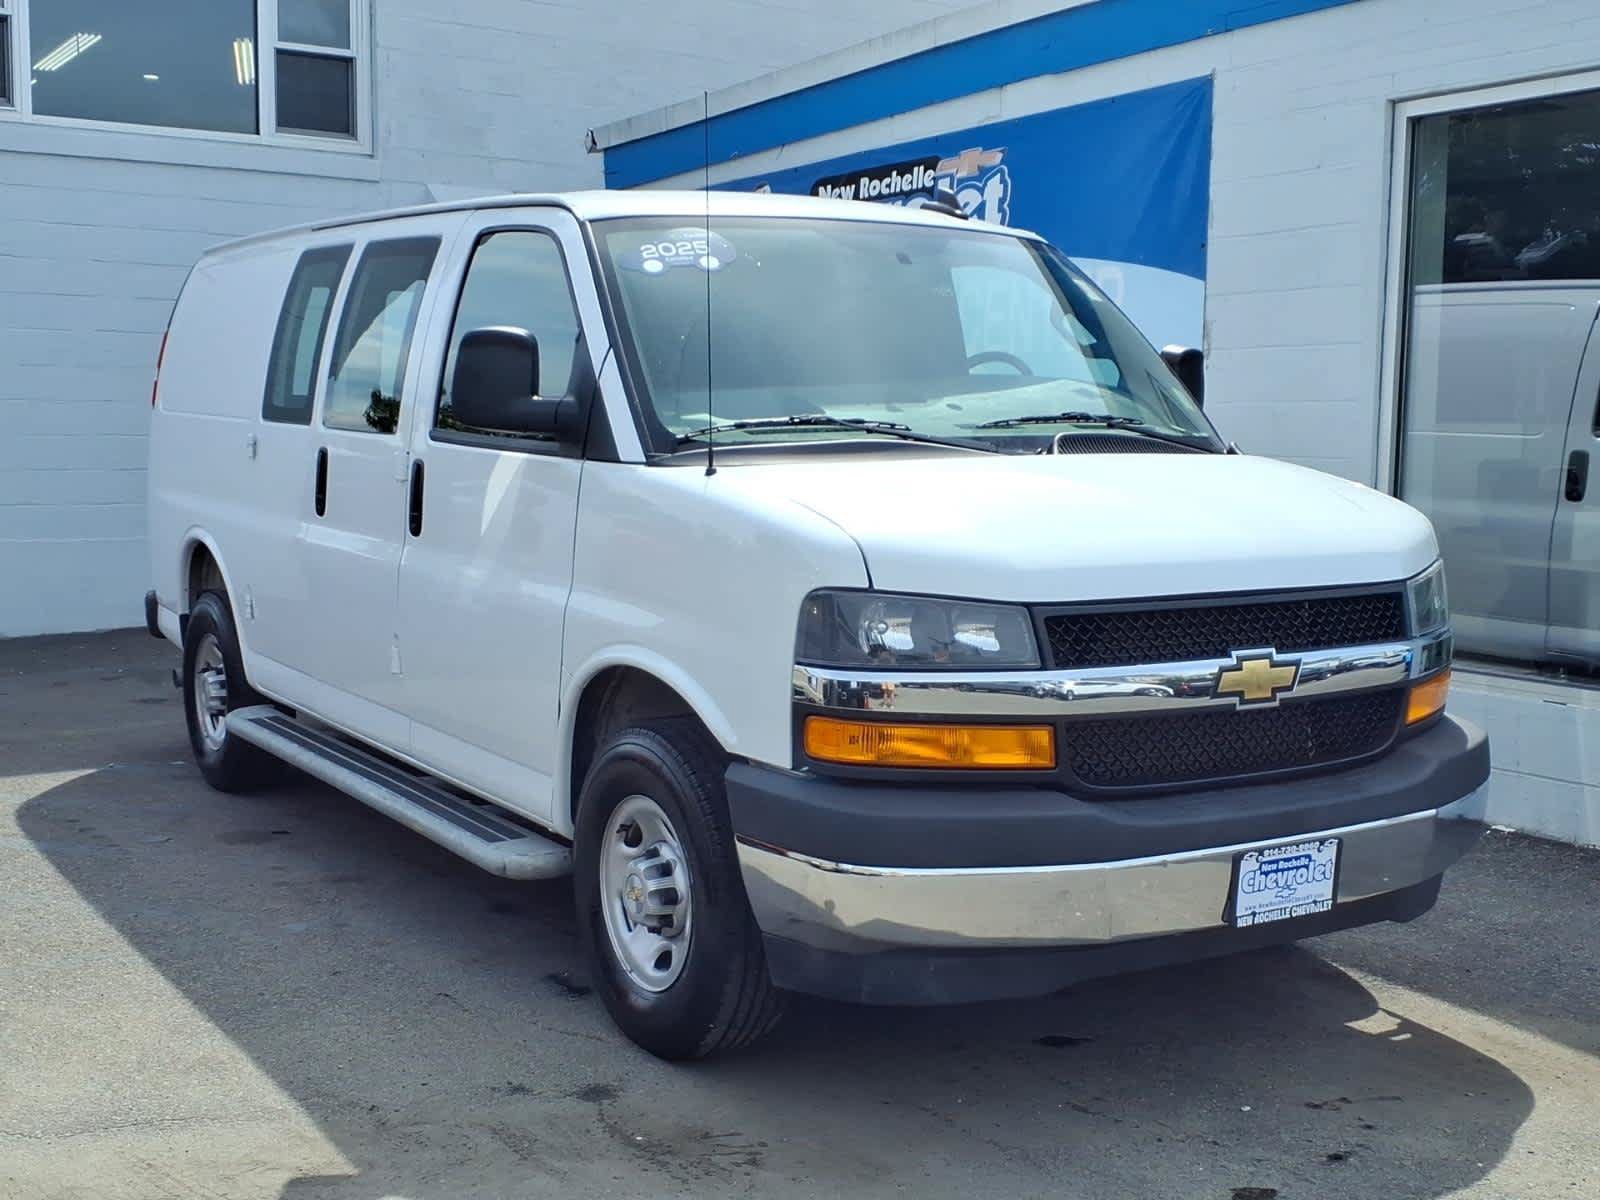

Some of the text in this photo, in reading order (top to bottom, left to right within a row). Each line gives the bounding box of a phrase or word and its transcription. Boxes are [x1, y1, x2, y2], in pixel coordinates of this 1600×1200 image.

[818, 183, 856, 200] New
[858, 164, 936, 200] Rochelle
[640, 240, 710, 259] 2025
[1241, 858, 1334, 894] Chevrolet
[1261, 857, 1309, 873] New Rochelle
[1236, 901, 1332, 928] NEW ROCHELLE CHEVROLET
